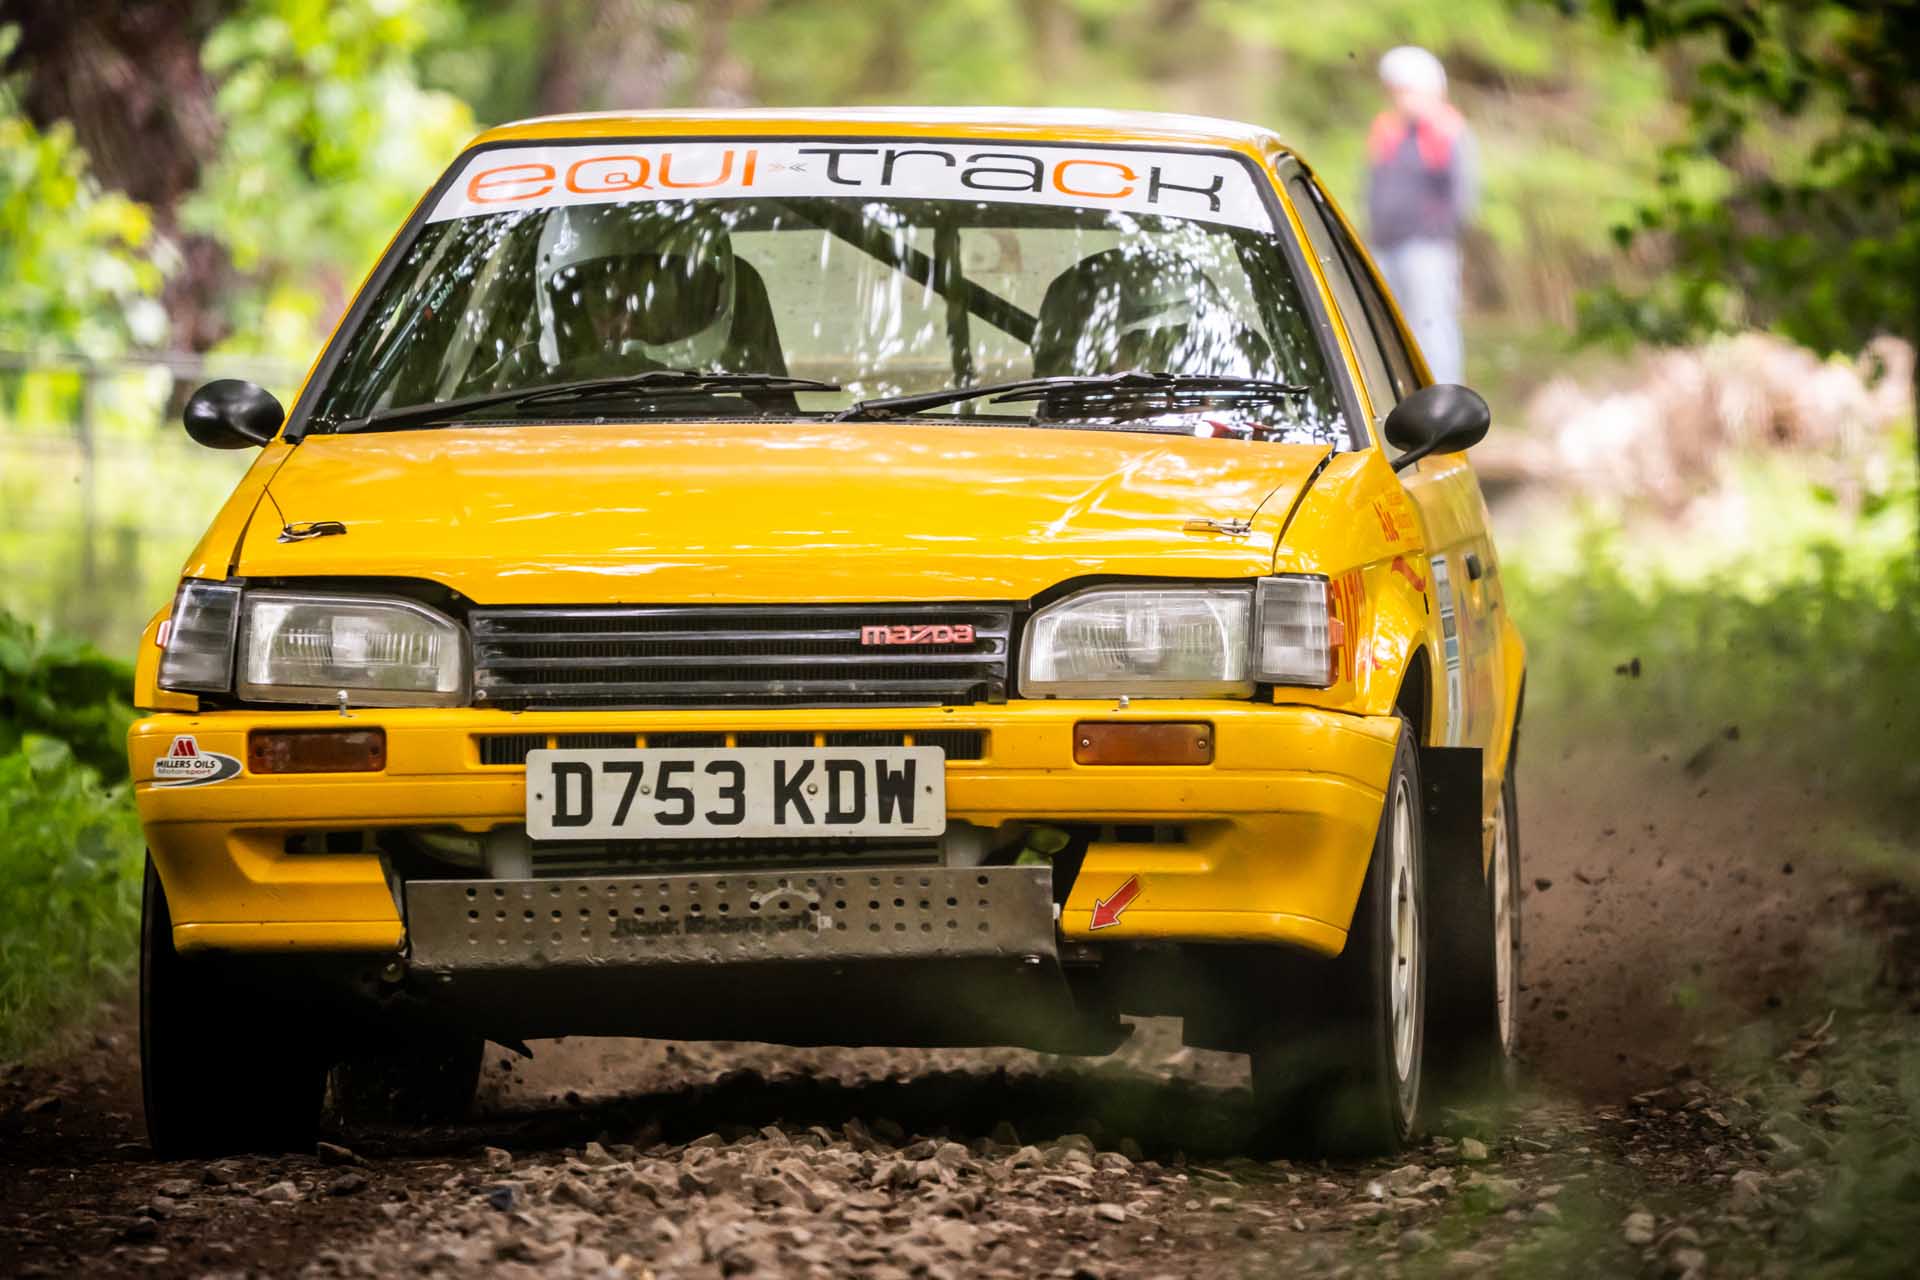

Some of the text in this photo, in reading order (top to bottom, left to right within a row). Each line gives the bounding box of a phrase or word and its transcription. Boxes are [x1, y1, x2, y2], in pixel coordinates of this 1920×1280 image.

[156, 760, 216, 768] MILLERS OILS
[551, 758, 917, 828] D753 KDW
